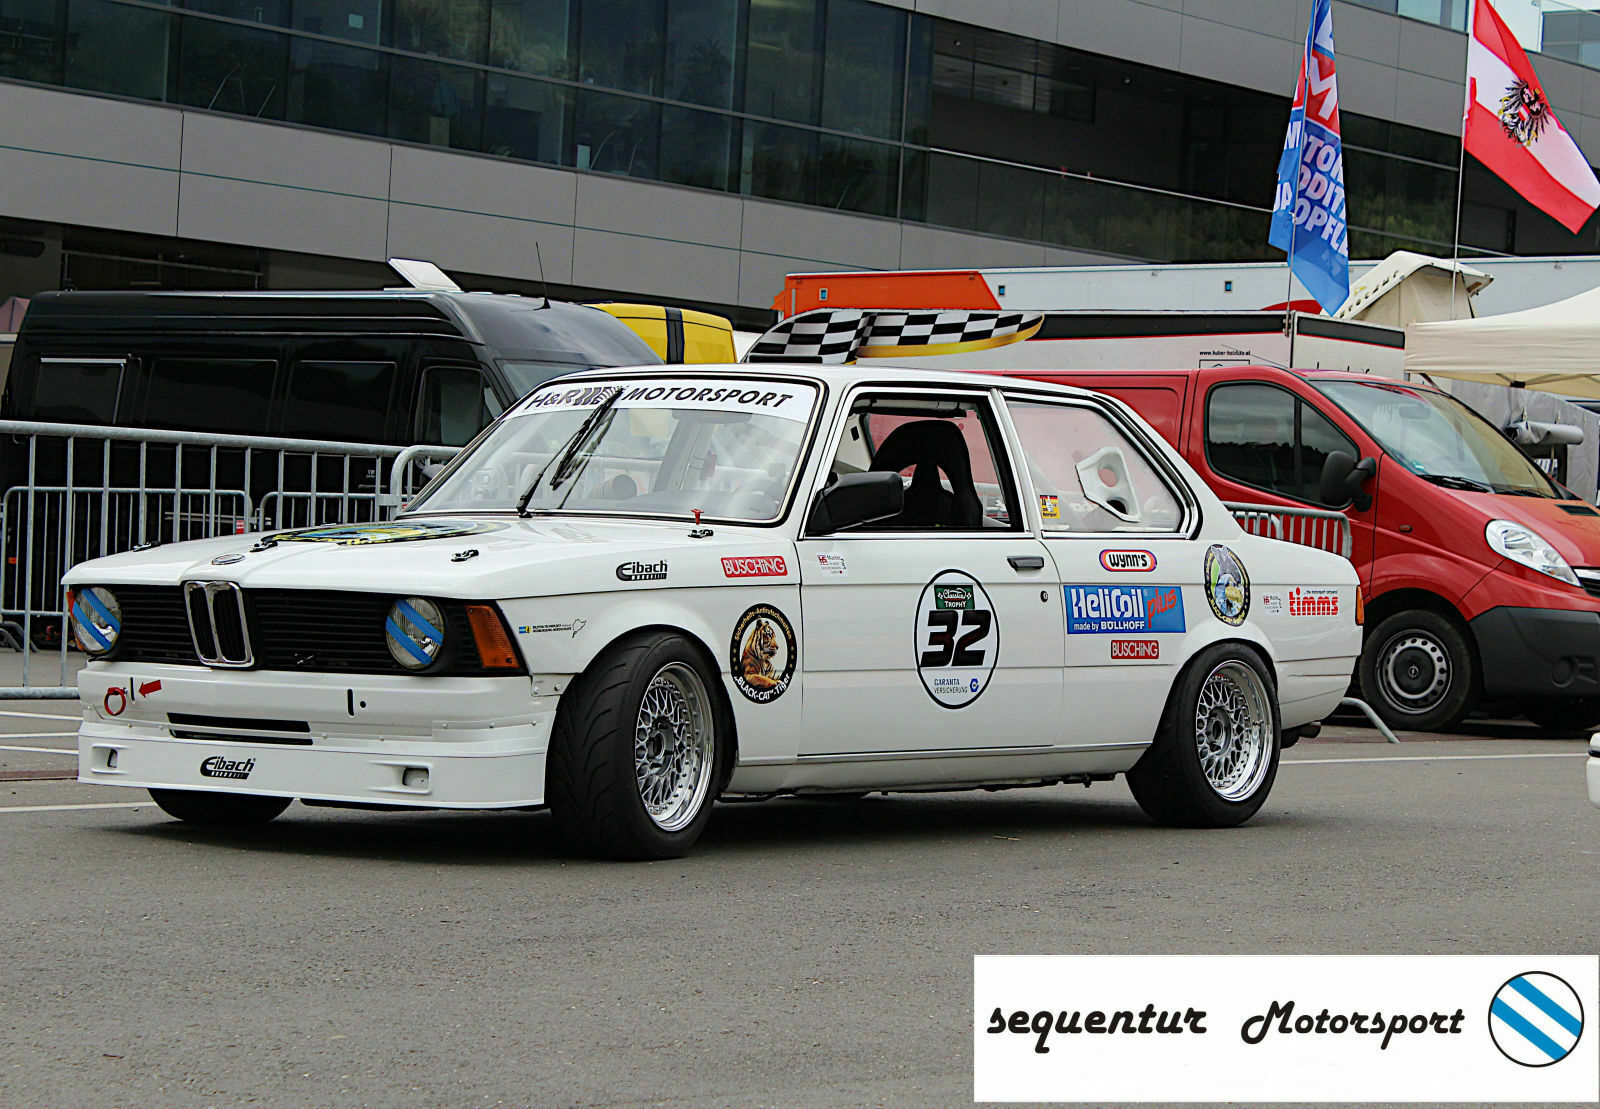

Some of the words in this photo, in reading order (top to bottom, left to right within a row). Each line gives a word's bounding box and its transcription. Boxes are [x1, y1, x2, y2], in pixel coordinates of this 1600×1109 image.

[622, 387, 795, 408] MOTORSPORT
[616, 560, 668, 581] Eibach
[1070, 588, 1145, 618] HeliCoil
[1147, 588, 1178, 628] plus
[1288, 587, 1338, 616] timms
[1073, 622, 1090, 630] made
[1091, 621, 1099, 631] by
[920, 609, 991, 667] 32
[933, 678, 960, 686] GARANTA
[200, 756, 255, 779] Eibach
